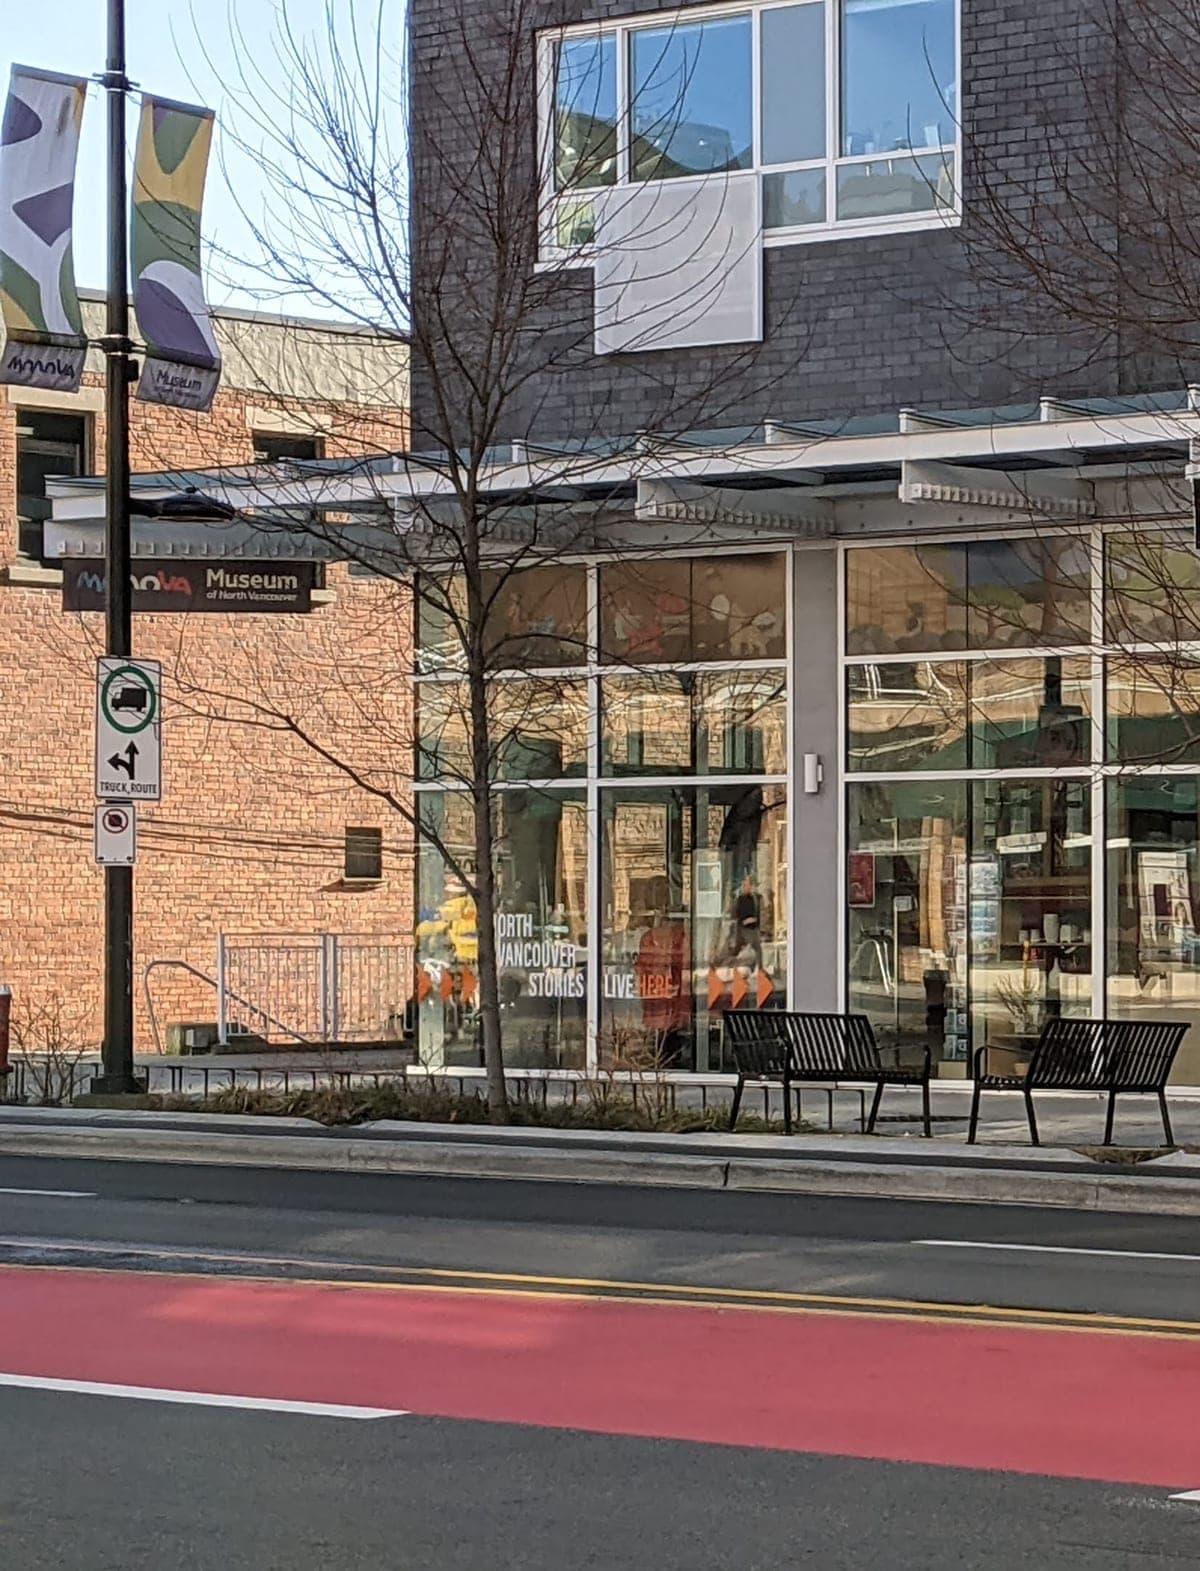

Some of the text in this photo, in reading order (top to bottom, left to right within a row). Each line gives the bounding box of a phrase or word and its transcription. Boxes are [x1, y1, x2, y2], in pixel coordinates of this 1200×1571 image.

[157, 370, 202, 391] Museum
[206, 568, 298, 589] Museum
[206, 590, 217, 599] of
[219, 590, 248, 600] North
[100, 782, 157, 794] TRUCK ROUTE
[498, 941, 576, 968] VANCOUVER
[528, 972, 673, 999] STORIES LIVE HERE
